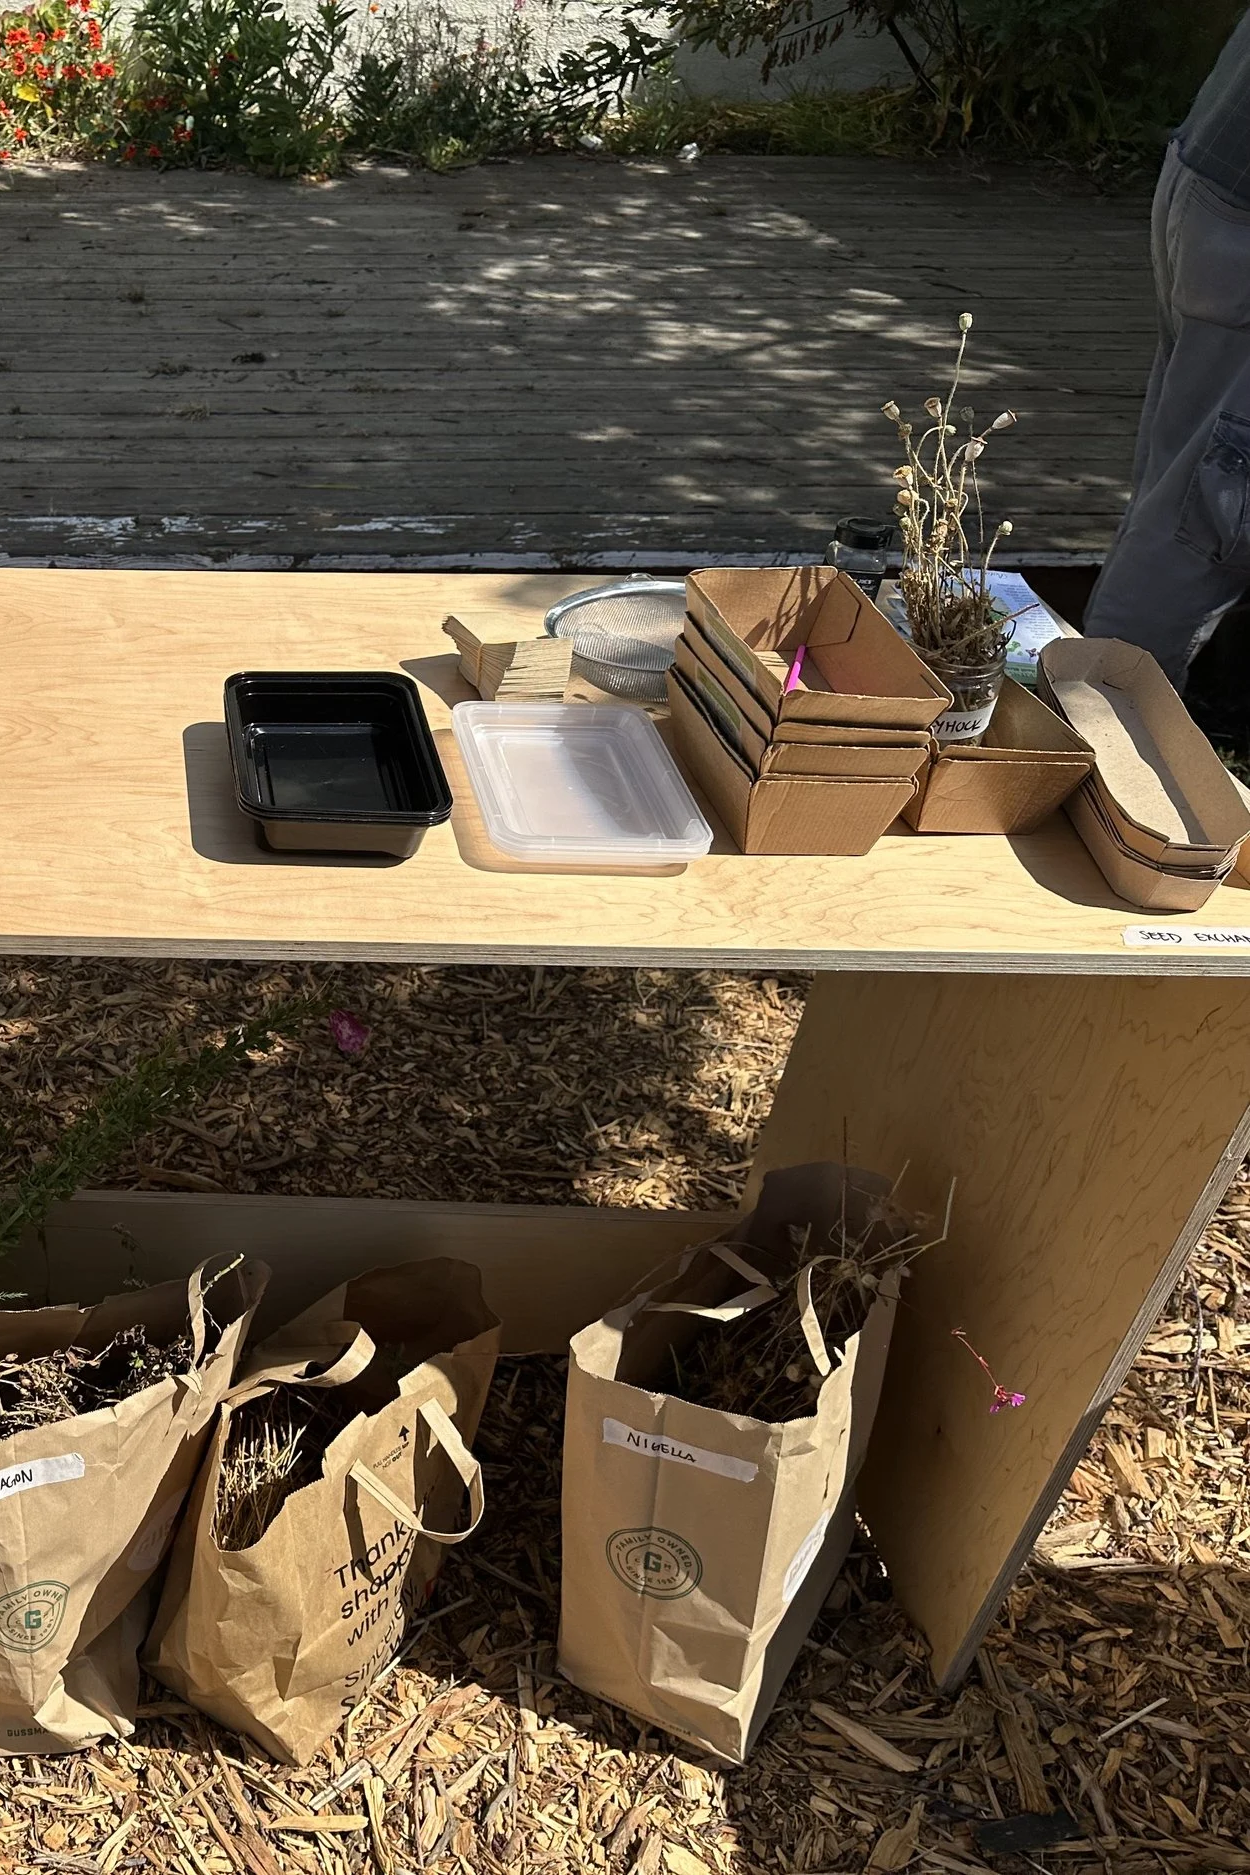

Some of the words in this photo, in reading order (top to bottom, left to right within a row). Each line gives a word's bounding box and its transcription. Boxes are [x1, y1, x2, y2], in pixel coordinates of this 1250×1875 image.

[933, 719, 982, 734] YHOCK
[1139, 930, 1182, 944] SEED
[392, 1451, 402, 1462] OUT
[626, 1432, 697, 1463] NIGELLA
[334, 1520, 410, 1588] Thank
[616, 1534, 652, 1552] FAMILY
[658, 1536, 692, 1568] OWNED
[644, 1551, 662, 1573] G
[341, 1548, 411, 1620] shopp
[626, 1566, 654, 1584] SINCE
[34, 1589, 64, 1601] OWNE
[24, 1610, 42, 1630] G
[347, 1597, 388, 1647] with
[9, 1628, 36, 1640] SINCE
